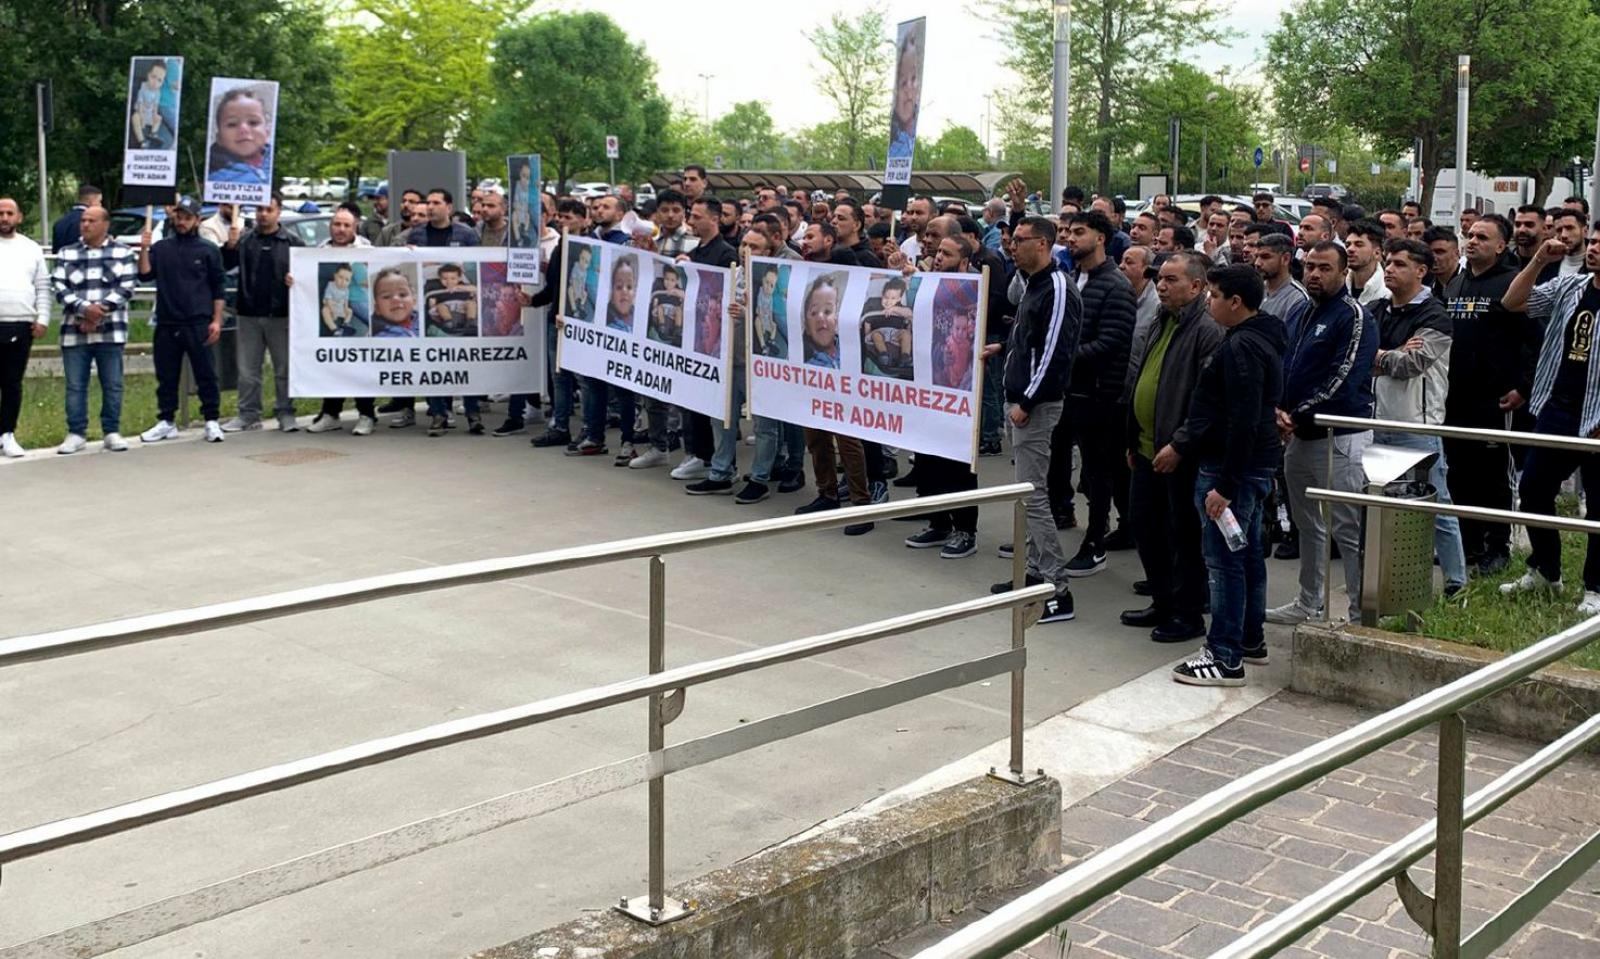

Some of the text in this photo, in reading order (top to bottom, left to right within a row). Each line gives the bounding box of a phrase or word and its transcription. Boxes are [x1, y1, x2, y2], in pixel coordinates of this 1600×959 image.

[212, 183, 263, 192] GIUSTIZIA
[234, 194, 263, 202] ADAM
[315, 346, 528, 363] GIUSTIZIA E CHIAREZZA
[564, 323, 720, 383] GIUSTIZIA E CHIAREZZA
[379, 370, 469, 386] PER ADAM
[606, 360, 672, 395] PER ADAM
[753, 359, 972, 417] GIUSTIZIA E CHIAREZZA
[811, 398, 903, 434] PER ADAM
